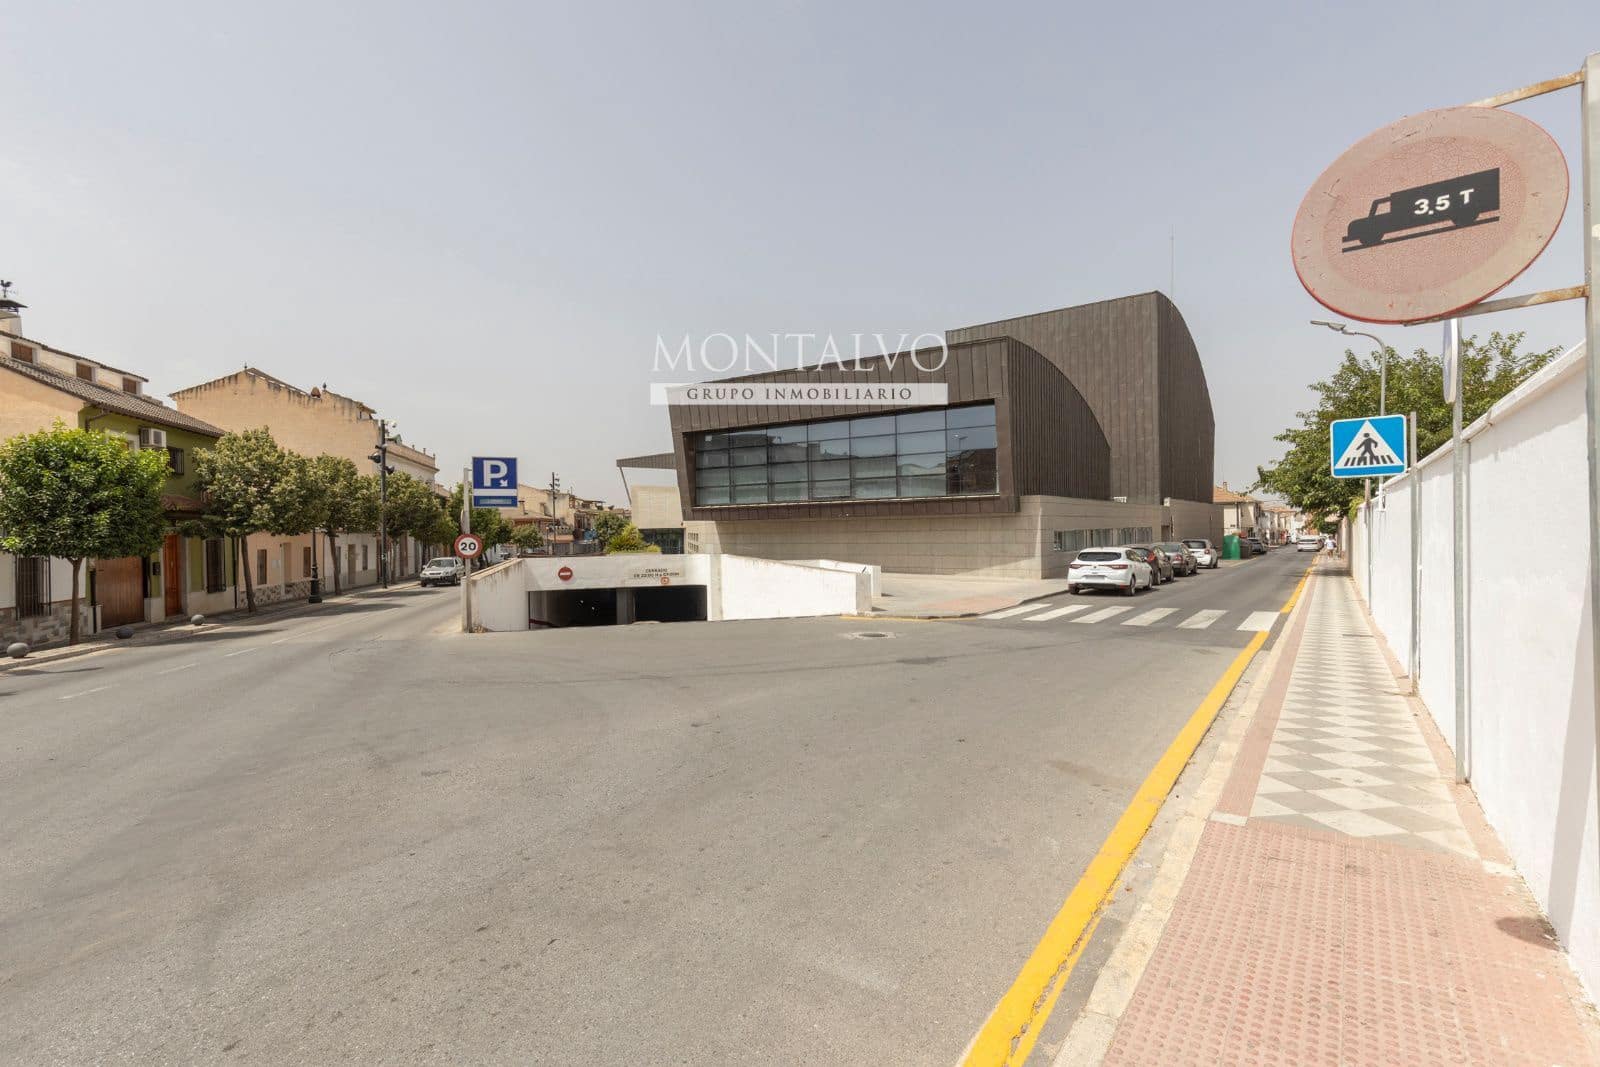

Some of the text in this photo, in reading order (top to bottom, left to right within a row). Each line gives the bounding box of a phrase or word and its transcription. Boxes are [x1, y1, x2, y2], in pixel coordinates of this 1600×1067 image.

[1459, 188, 1475, 204] T
[483, 460, 508, 487] P
[460, 542, 477, 551] 20
